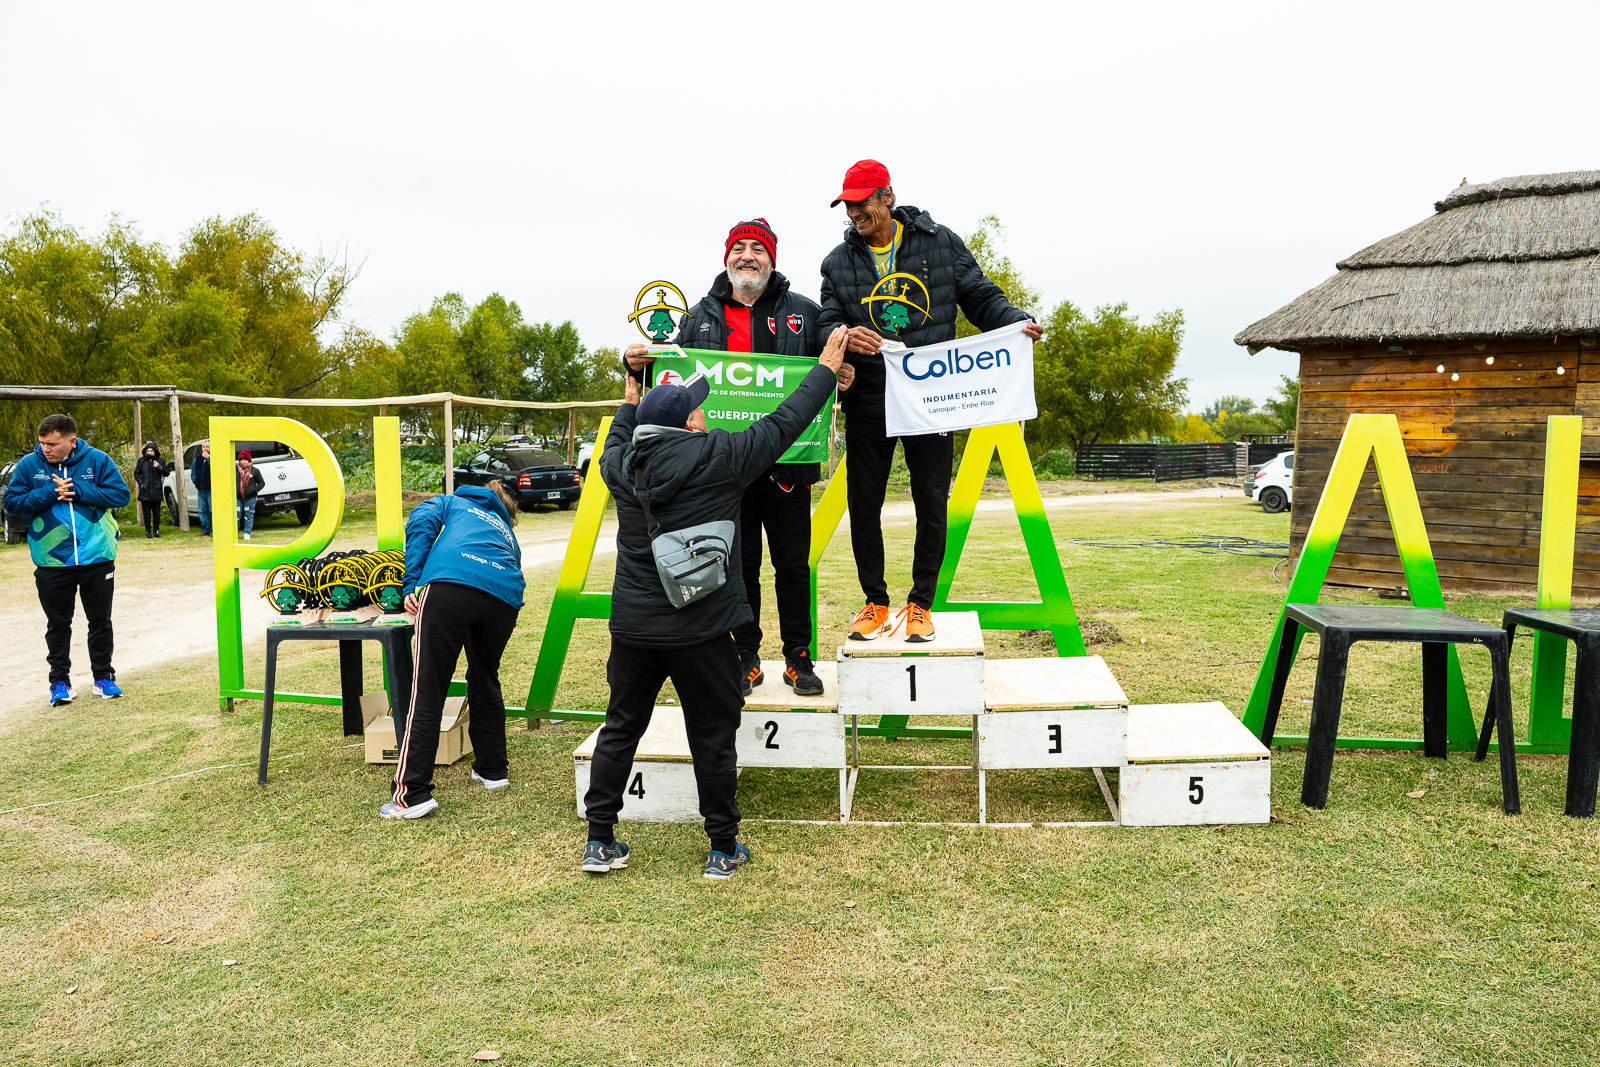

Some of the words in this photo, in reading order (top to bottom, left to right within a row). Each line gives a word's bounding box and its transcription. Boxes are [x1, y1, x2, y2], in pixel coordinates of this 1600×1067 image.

[695, 359, 785, 388] MCM
[902, 348, 1011, 381] Colben
[729, 390, 785, 399] ENTRENAMIENTO
[922, 387, 998, 404] INDUMENTARIA
[928, 405, 957, 414] Larroque
[961, 402, 979, 410] Entre
[906, 665, 916, 701] 1
[765, 721, 779, 749] 2
[1048, 725, 1061, 753] 3
[629, 772, 645, 799] 4
[1189, 777, 1203, 804] 5
